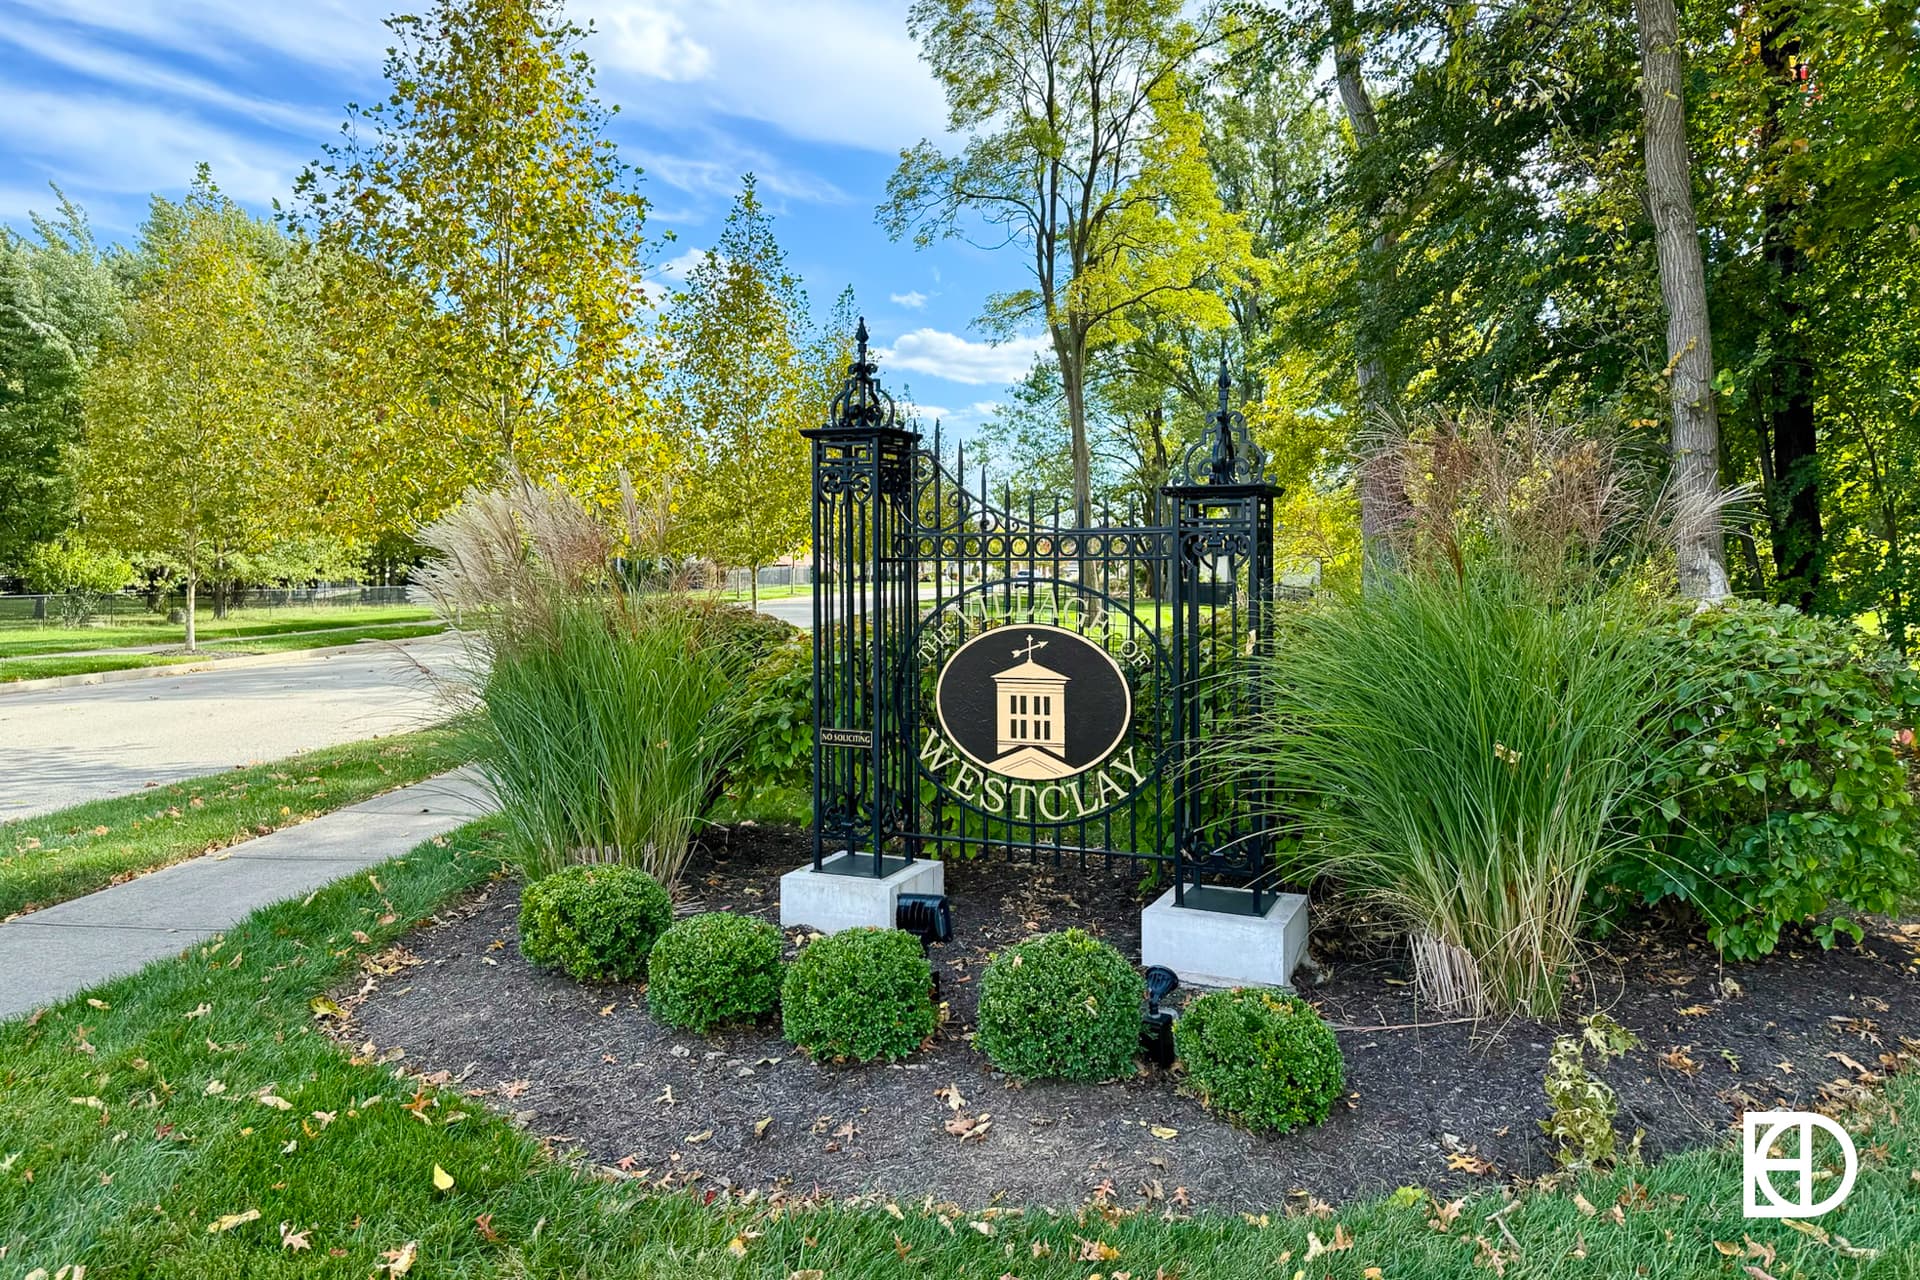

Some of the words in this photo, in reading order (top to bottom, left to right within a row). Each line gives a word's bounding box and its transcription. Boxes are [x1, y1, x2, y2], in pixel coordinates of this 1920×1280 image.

[916, 622, 957, 664] THE
[946, 589, 1115, 641] VILLAGE
[1119, 639, 1151, 667] OF
[822, 732, 833, 741] NO
[834, 733, 871, 744] SOLICITING
[919, 727, 1147, 821] WESTCLAY
